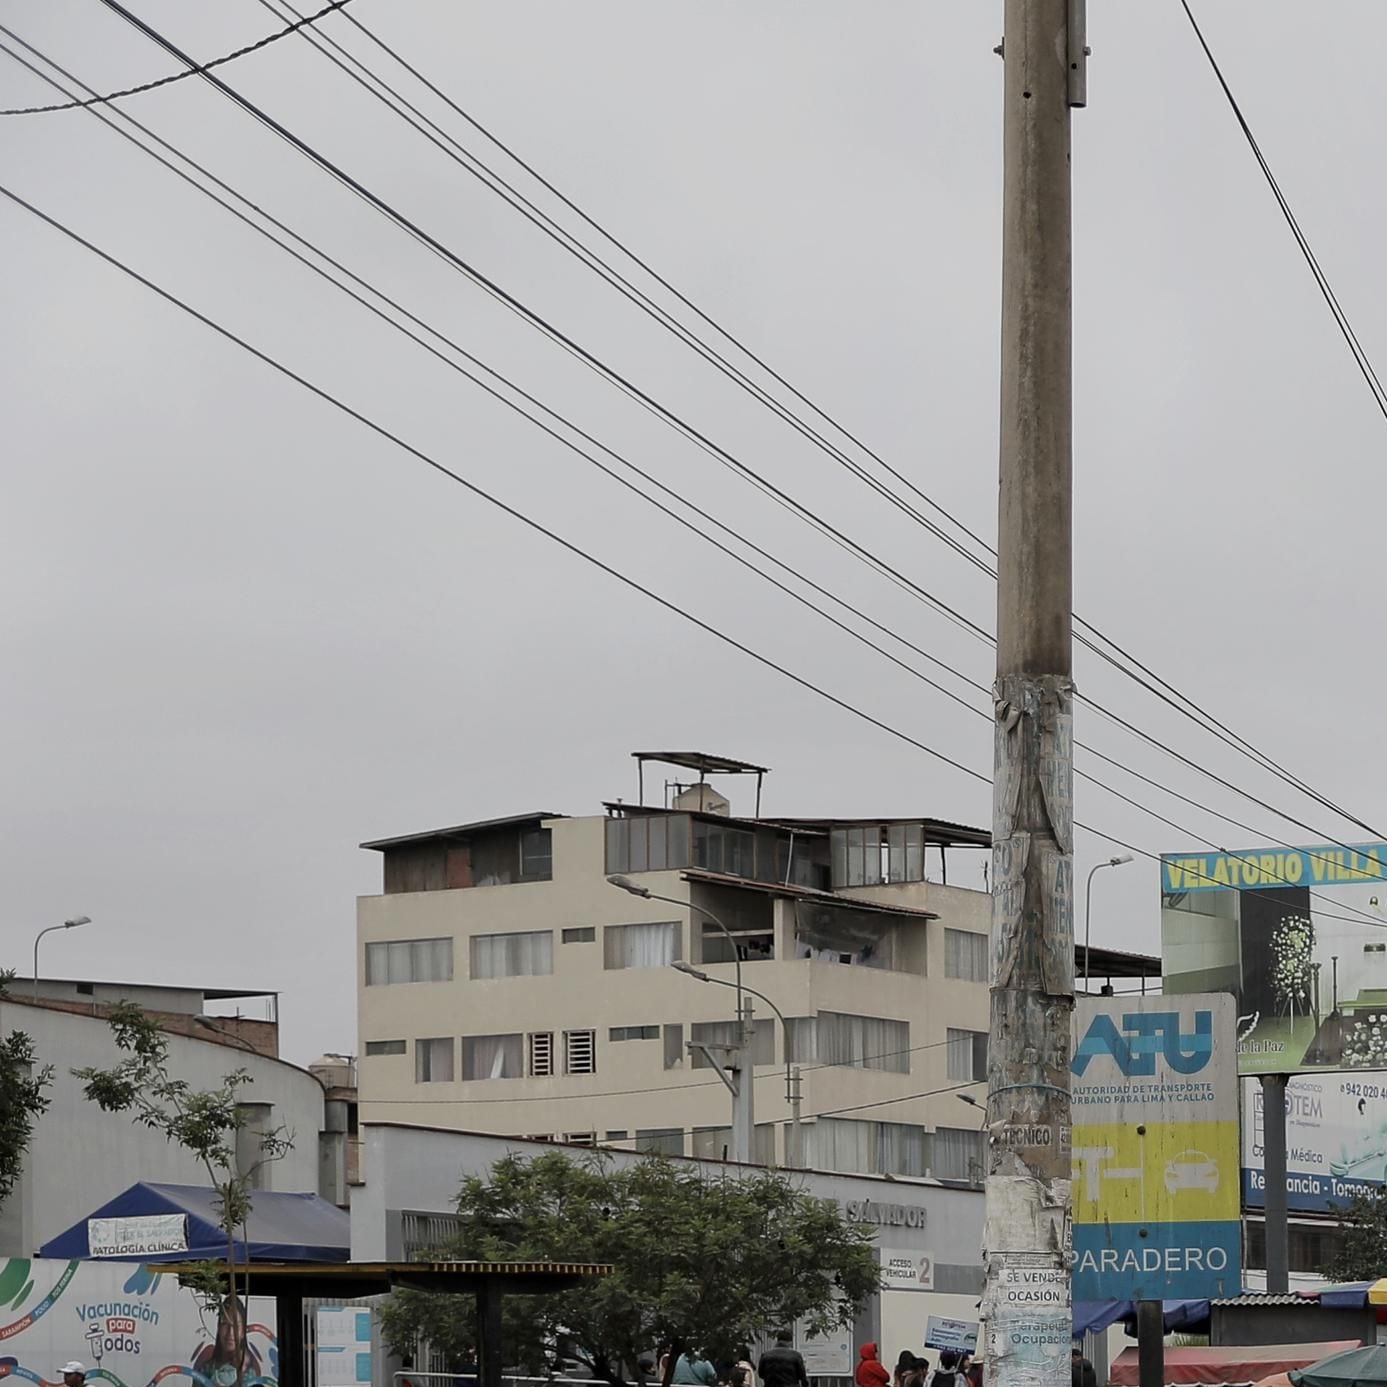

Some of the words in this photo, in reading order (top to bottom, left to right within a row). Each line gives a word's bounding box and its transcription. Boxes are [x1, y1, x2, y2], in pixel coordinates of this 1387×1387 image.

[1168, 852, 1303, 888] VELATORIO
[1310, 849, 1382, 881] VILLA
[1071, 1011, 1212, 1077] ATU
[1264, 1040, 1284, 1052] Paz
[1073, 1085, 1130, 1095] AUTORIDAD
[1133, 1084, 1145, 1093] DE
[1149, 1083, 1212, 1092] TRANSPORTE
[1346, 1083, 1361, 1097] 942
[1363, 1085, 1379, 1098] 020
[1071, 1096, 1111, 1105] URBANO
[1114, 1096, 1140, 1104] PARA
[1142, 1095, 1164, 1103] LIMA
[1176, 1093, 1215, 1102] CALLAO
[1290, 1148, 1323, 1163] Médica
[1250, 1170, 1321, 1195] Reancia
[847, 1200, 927, 1229] SALVADOR
[93, 1243, 145, 1255] PATOLOGÍA
[147, 1241, 185, 1253] CLÍNICA
[886, 1269, 917, 1280] VEHICULAR
[889, 1258, 912, 1269] ACCESO
[919, 1257, 930, 1284] 2
[1007, 1273, 1019, 1282] SE
[1007, 1289, 1060, 1302] OCASIÓN
[76, 1302, 160, 1325] Vacunación
[109, 1319, 134, 1332] para
